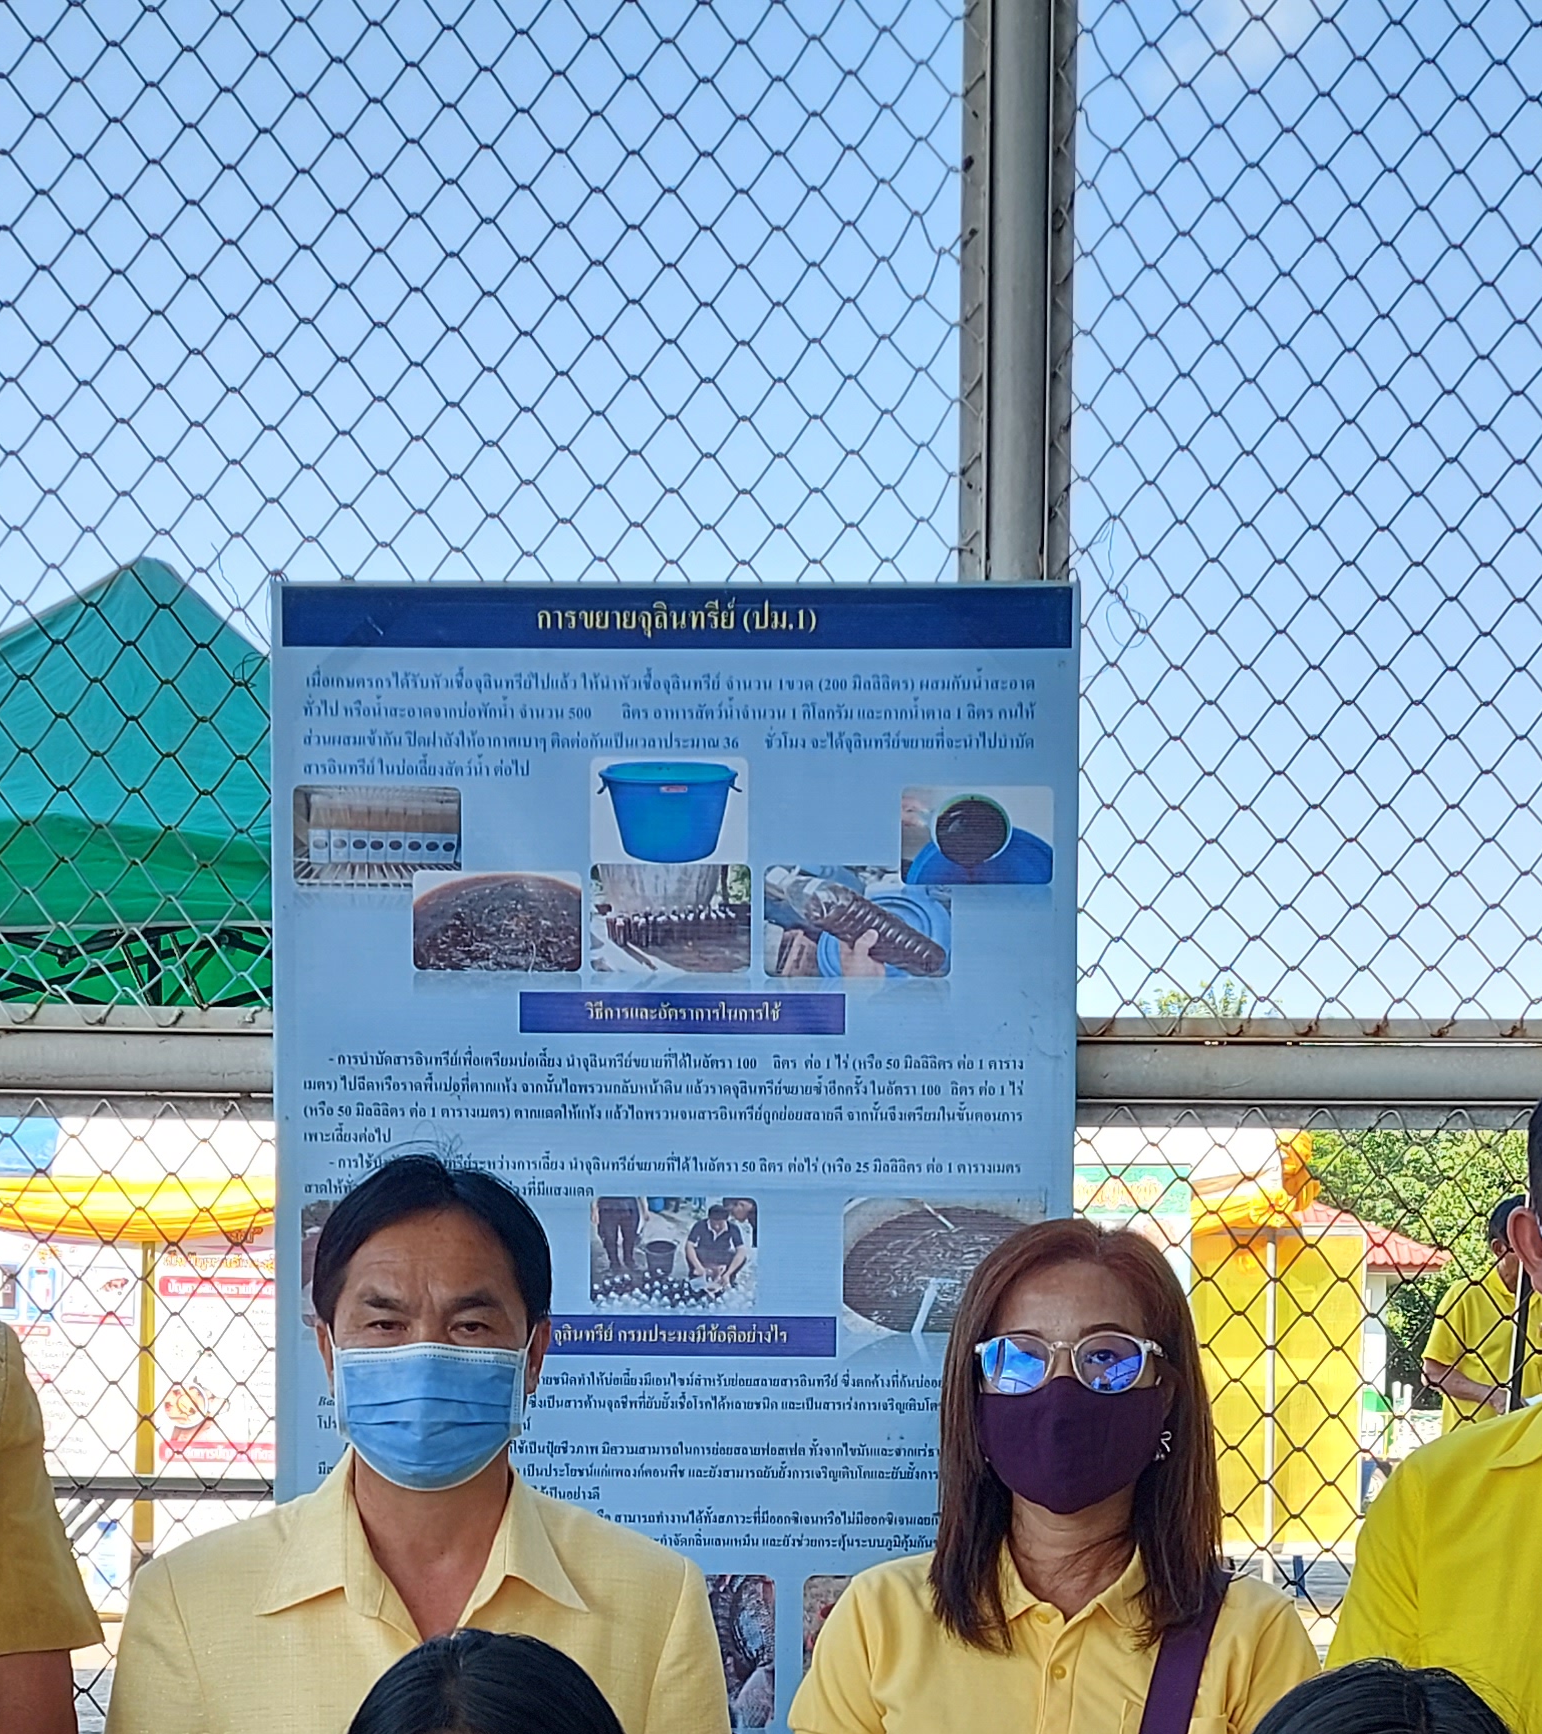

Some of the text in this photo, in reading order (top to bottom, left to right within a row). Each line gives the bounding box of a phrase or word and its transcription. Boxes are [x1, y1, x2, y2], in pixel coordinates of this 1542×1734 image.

[537, 597, 818, 639] การขยายจุลินทรีย์ (ปม.1)
[819, 679, 847, 692] (200
[853, 674, 914, 692] มิลลิลิตร)
[920, 668, 1034, 691] ผสมกับน้ำสะอาด
[303, 694, 338, 717] ทั่วไป
[520, 704, 564, 719] จำนวน
[569, 707, 591, 719] 500
[622, 703, 648, 720] ลิตร
[792, 707, 796, 720] 1
[802, 703, 853, 720] กิโลกรัม
[858, 697, 951, 720] และกากน้ำตาล
[957, 707, 961, 720] 1
[967, 703, 993, 720] ลิตร
[723, 737, 738, 750] 36
[765, 726, 805, 749] ชั่วโมง
[304, 757, 374, 775] สารอินทรีย์
[494, 758, 529, 776] ต่อไป
[737, 1057, 757, 1069] 100
[773, 1054, 796, 1070] ลิตร
[804, 1053, 821, 1070] ต่อ
[826, 1057, 830, 1070] 1
[834, 1053, 849, 1071] ไร่
[852, 1054, 882, 1072] (หรือ
[886, 1059, 900, 1070] 50
[904, 1054, 953, 1070] มิลลิลิตร
[957, 1054, 974, 1070] ต่อ
[979, 1059, 983, 1070] 1
[304, 1079, 338, 1093] เมตร)
[870, 1081, 916, 1096] ในอัตรา
[921, 1084, 941, 1098] 100
[950, 1079, 975, 1097] ลิตร
[979, 1080, 995, 1096] ต่อ
[1000, 1085, 1004, 1096] 1
[1008, 1080, 1024, 1096] ไร่
[304, 1101, 334, 1118] (หรือ
[337, 1105, 352, 1117] 50
[356, 1102, 405, 1118] มิลลิลิตร
[409, 1101, 428, 1119] ต่อ
[431, 1106, 436, 1118] 1
[742, 1161, 755, 1172] 50
[759, 1157, 783, 1173] ลิตร
[822, 1158, 851, 1175] (หรือ
[855, 1162, 869, 1173] 25
[873, 1158, 922, 1174] มิลลิลิตร
[926, 1157, 943, 1173] ต่อ
[948, 1162, 952, 1173] 1
[553, 1321, 613, 1348] จุลินทรีย์
